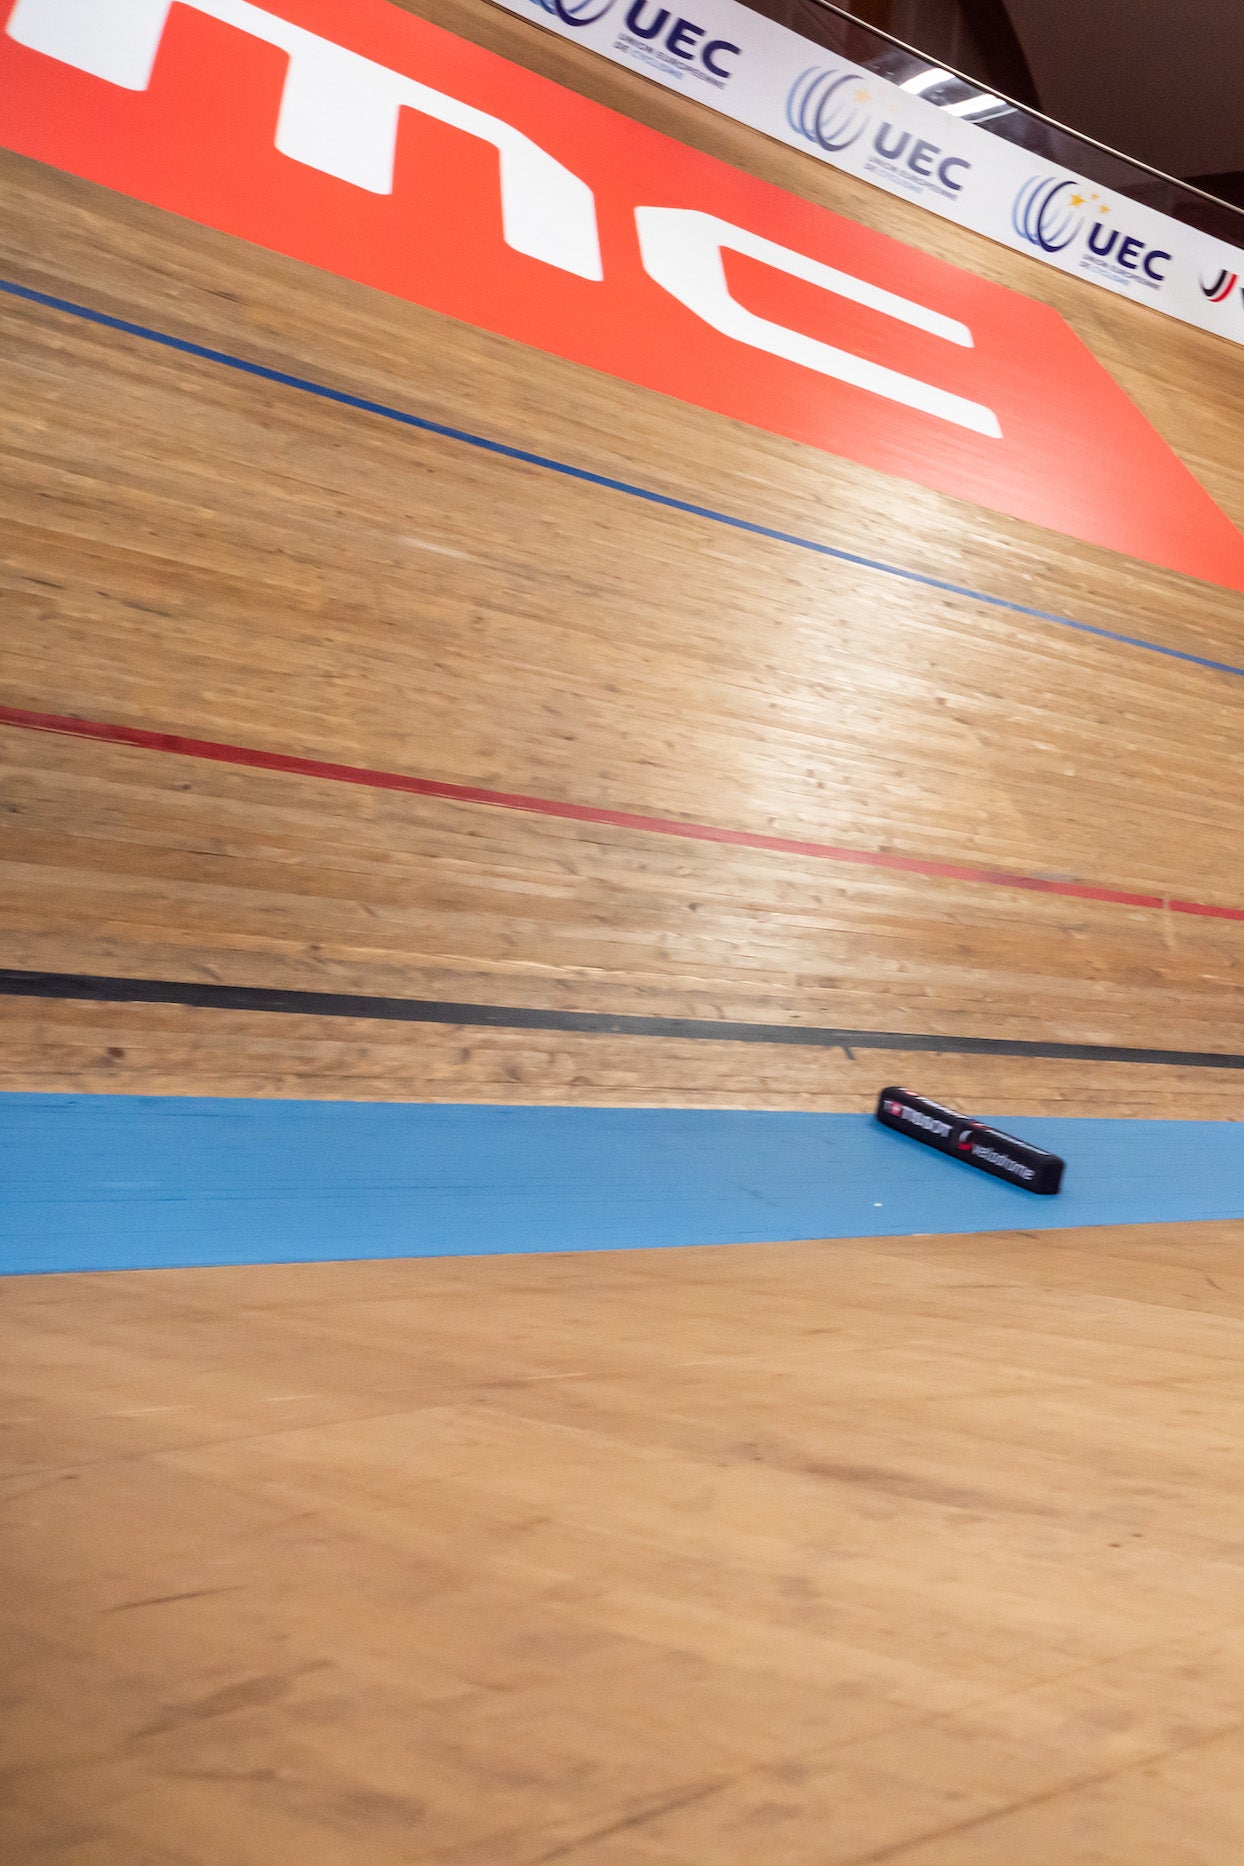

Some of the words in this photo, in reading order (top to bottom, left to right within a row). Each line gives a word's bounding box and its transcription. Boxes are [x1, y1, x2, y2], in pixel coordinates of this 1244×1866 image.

[625, 0, 741, 78] UEC
[874, 121, 971, 191] UEC
[1088, 222, 1172, 281] UEC
